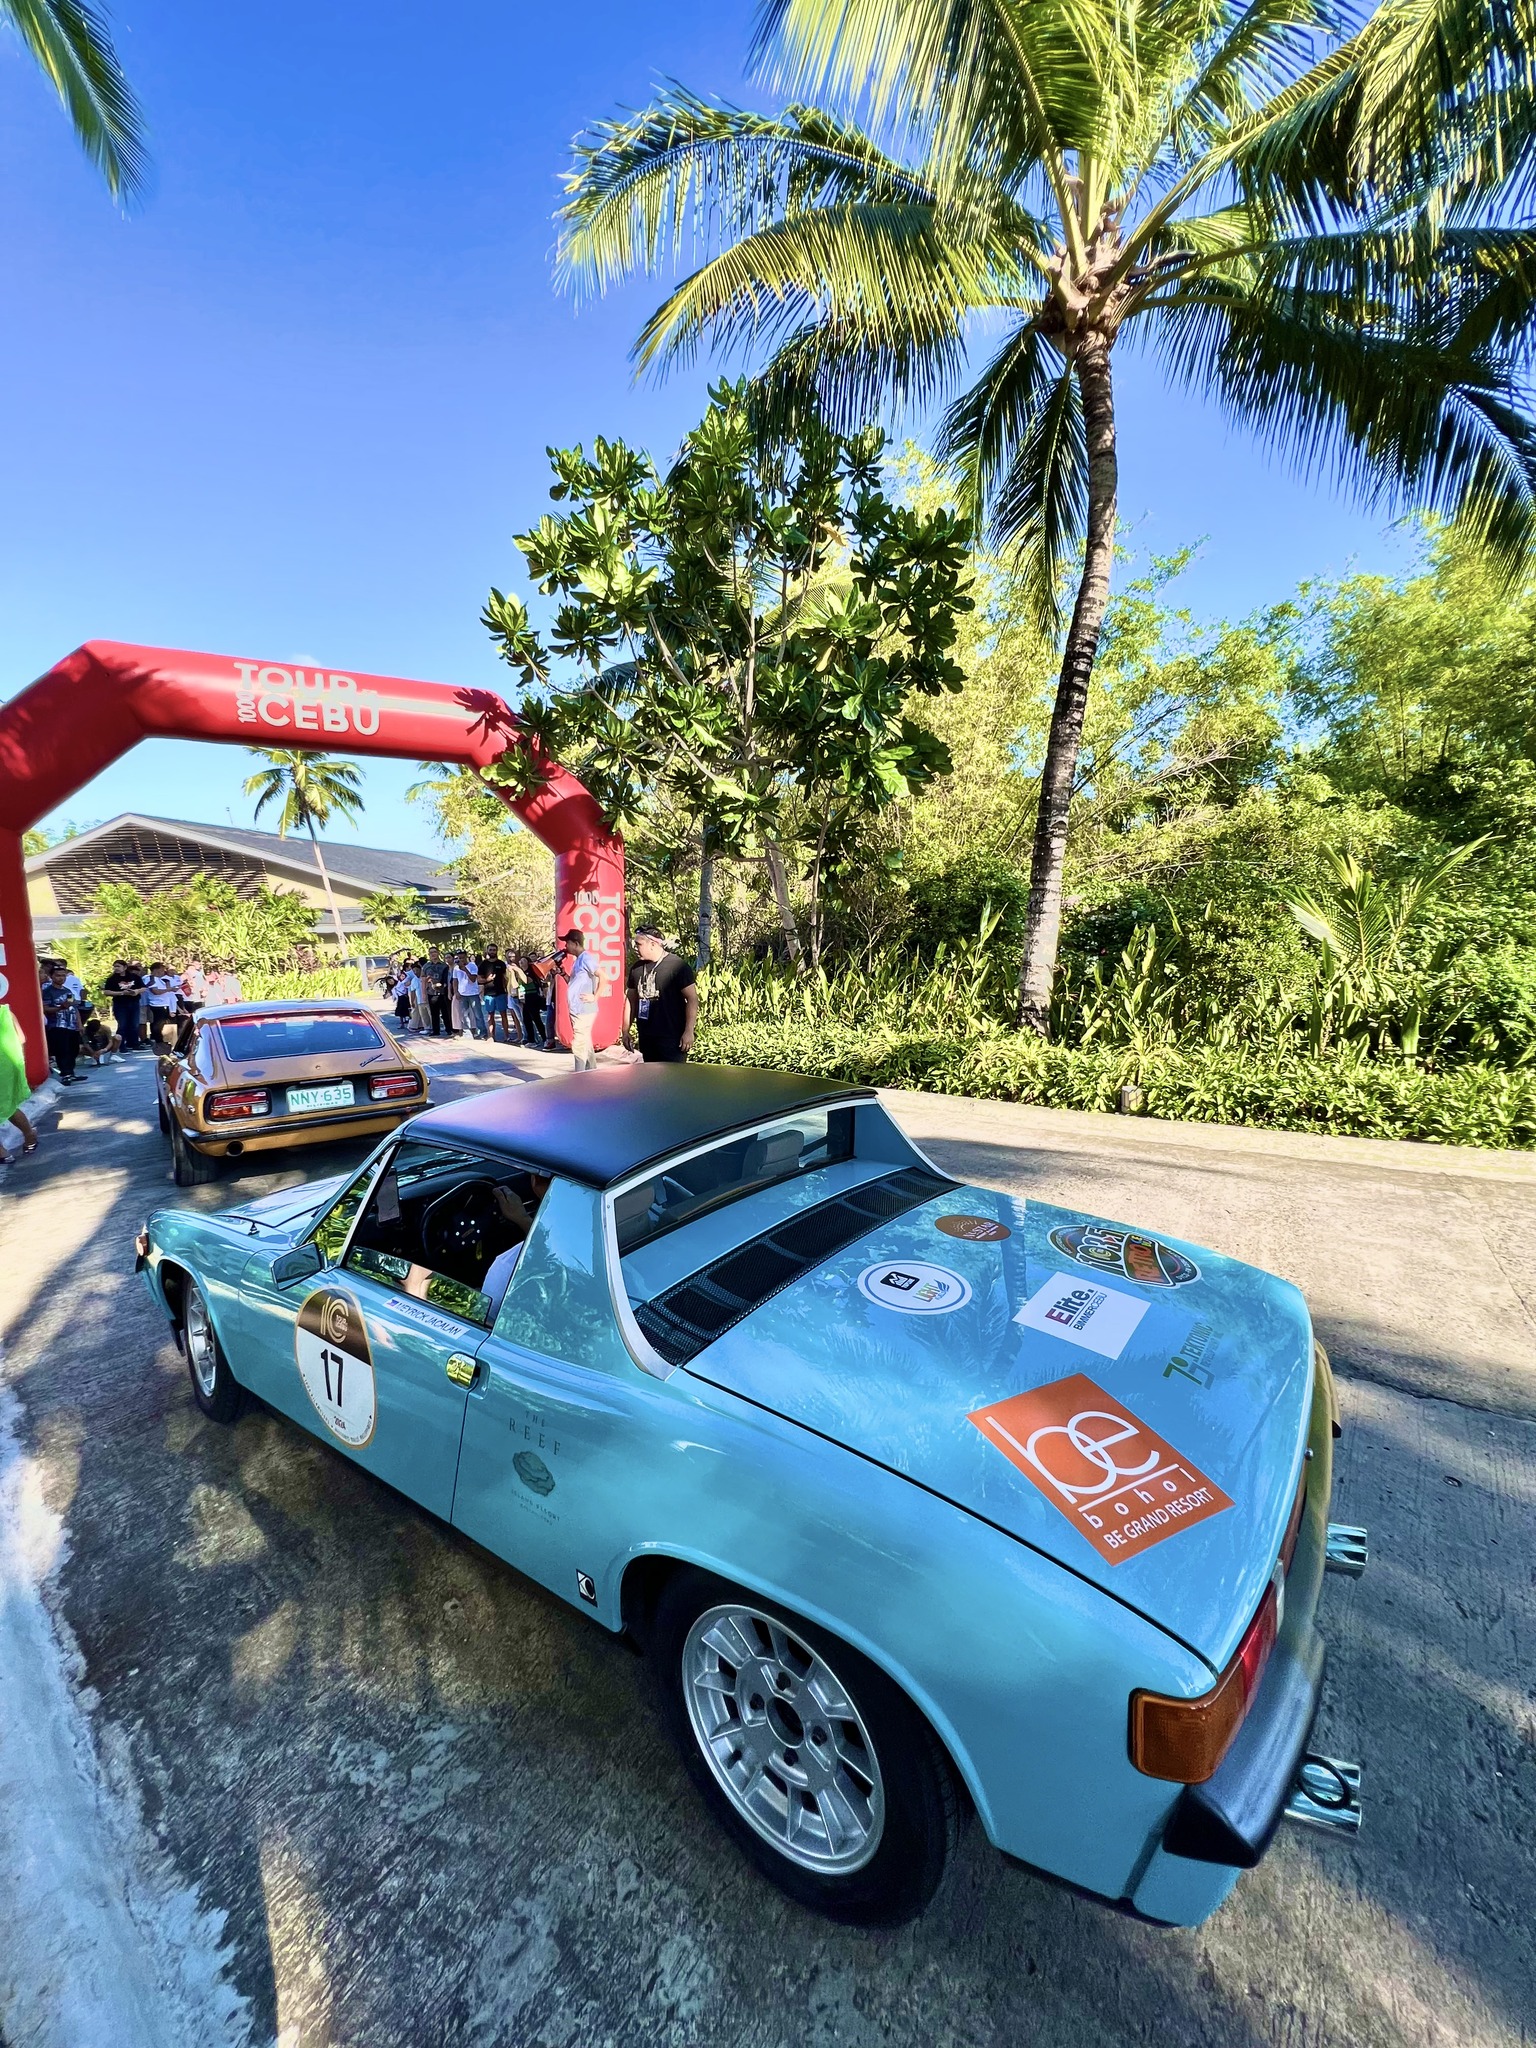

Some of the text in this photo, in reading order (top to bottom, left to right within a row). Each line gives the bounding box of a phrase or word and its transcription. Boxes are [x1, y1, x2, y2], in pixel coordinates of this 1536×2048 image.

[257, 692, 380, 735] CEBU
[425, 1316, 462, 1336] JACALAN
[320, 1349, 344, 1407] 17
[509, 1417, 561, 1456] REEF
[525, 1410, 546, 1428] THE
[1103, 1487, 1215, 1549] BE GRAND RESORT
